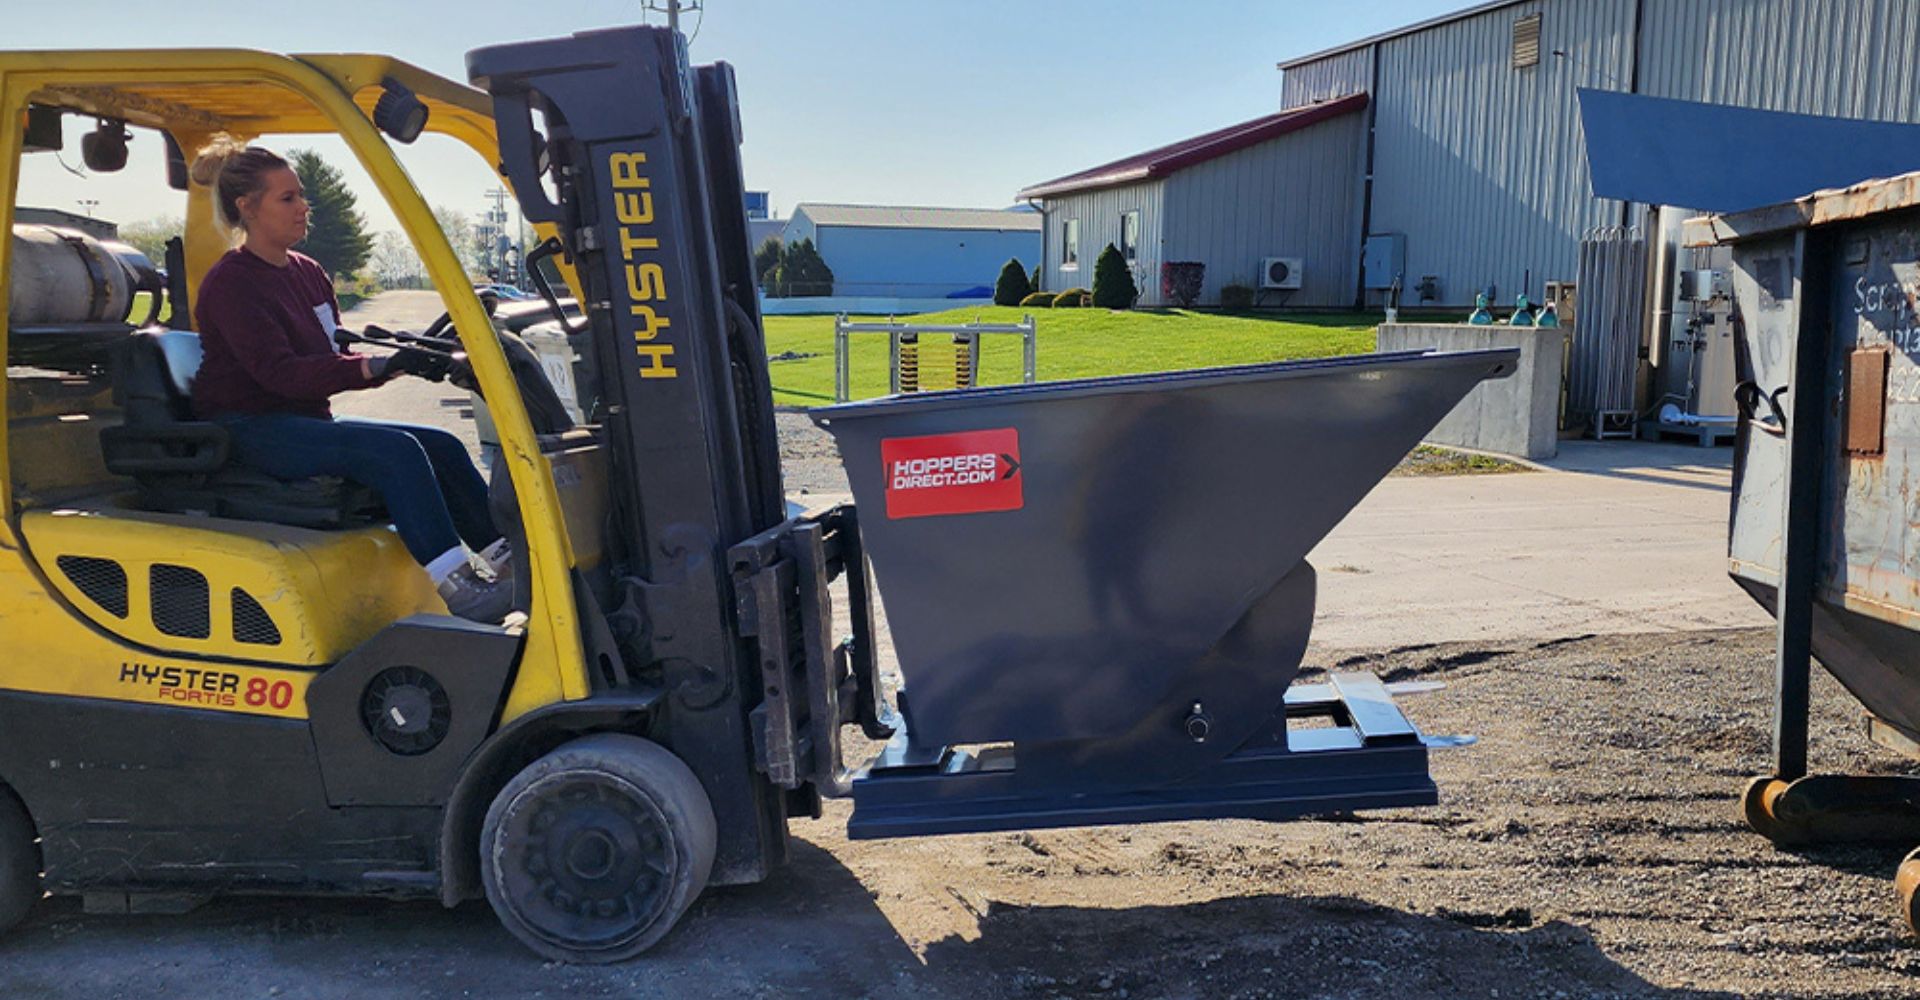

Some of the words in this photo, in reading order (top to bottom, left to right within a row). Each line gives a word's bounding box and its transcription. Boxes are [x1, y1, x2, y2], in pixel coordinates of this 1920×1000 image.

[609, 152, 677, 378] HYSTER
[894, 453, 996, 475] HOPPERS
[893, 470, 995, 490] DIRECT.COM
[119, 662, 240, 693] HYSTER
[244, 677, 293, 709] 80
[159, 687, 236, 706] FORTIS
